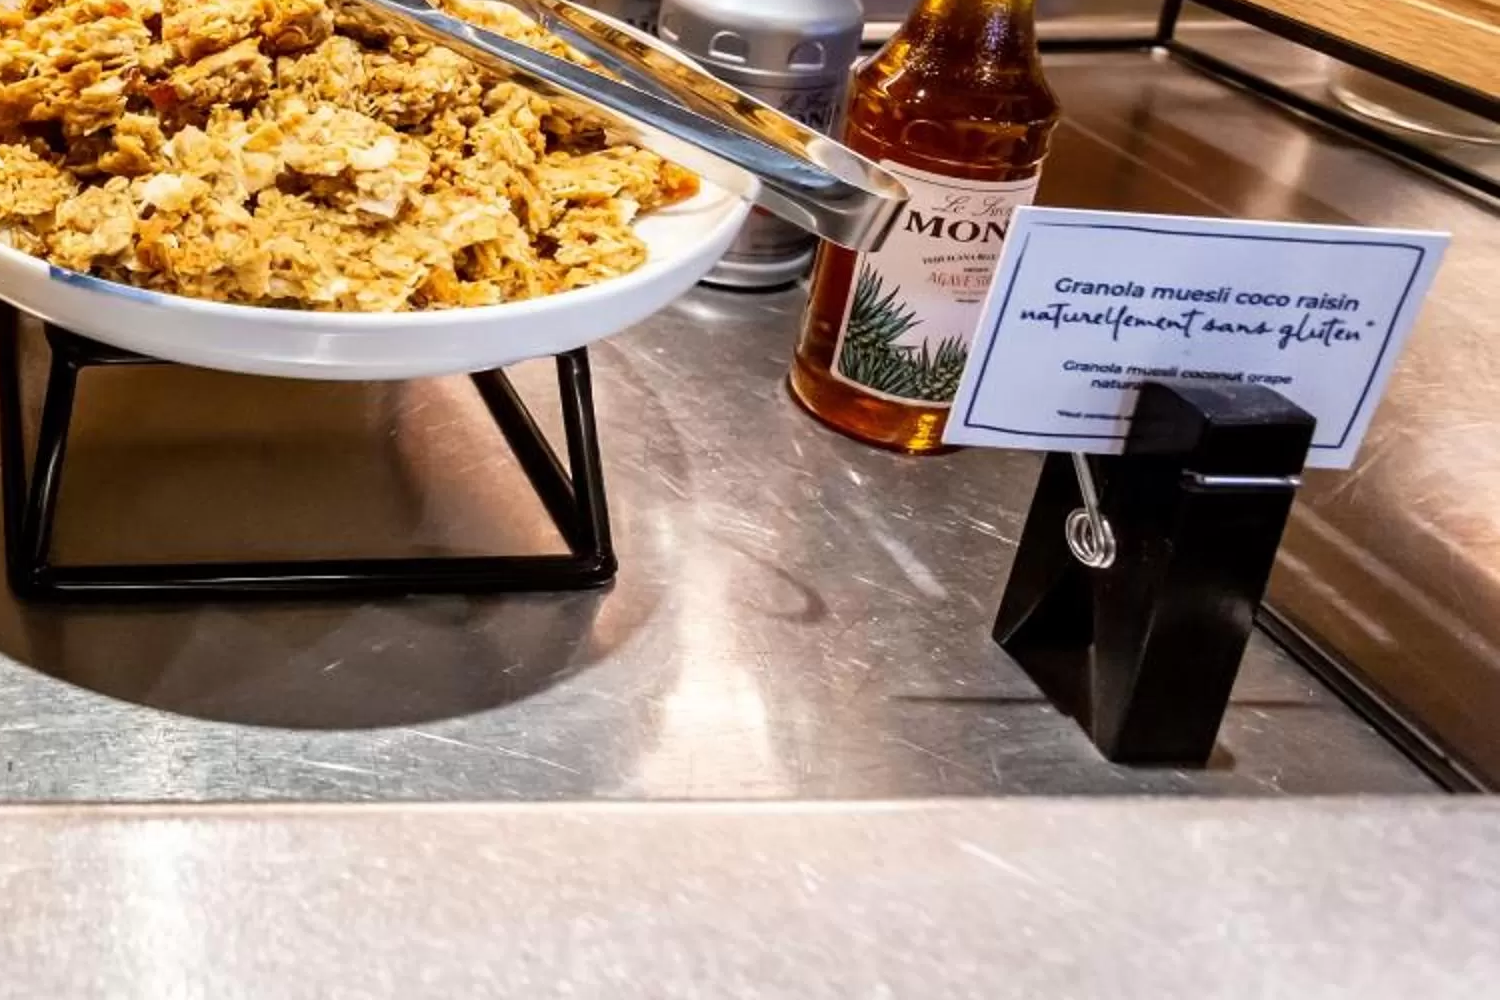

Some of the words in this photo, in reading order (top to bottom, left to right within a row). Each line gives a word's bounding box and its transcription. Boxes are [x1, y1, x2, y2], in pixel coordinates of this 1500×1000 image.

[903, 209, 1010, 243] MON
[1054, 276, 1146, 299] Granola
[1150, 286, 1232, 305] muesli
[1234, 291, 1291, 309] coco
[1295, 292, 1361, 313] raisin
[1201, 318, 1274, 336] sans
[1063, 359, 1124, 375] Granola
[1125, 365, 1178, 378] muesli
[1180, 369, 1244, 383] coconut
[1247, 373, 1293, 385] grape
